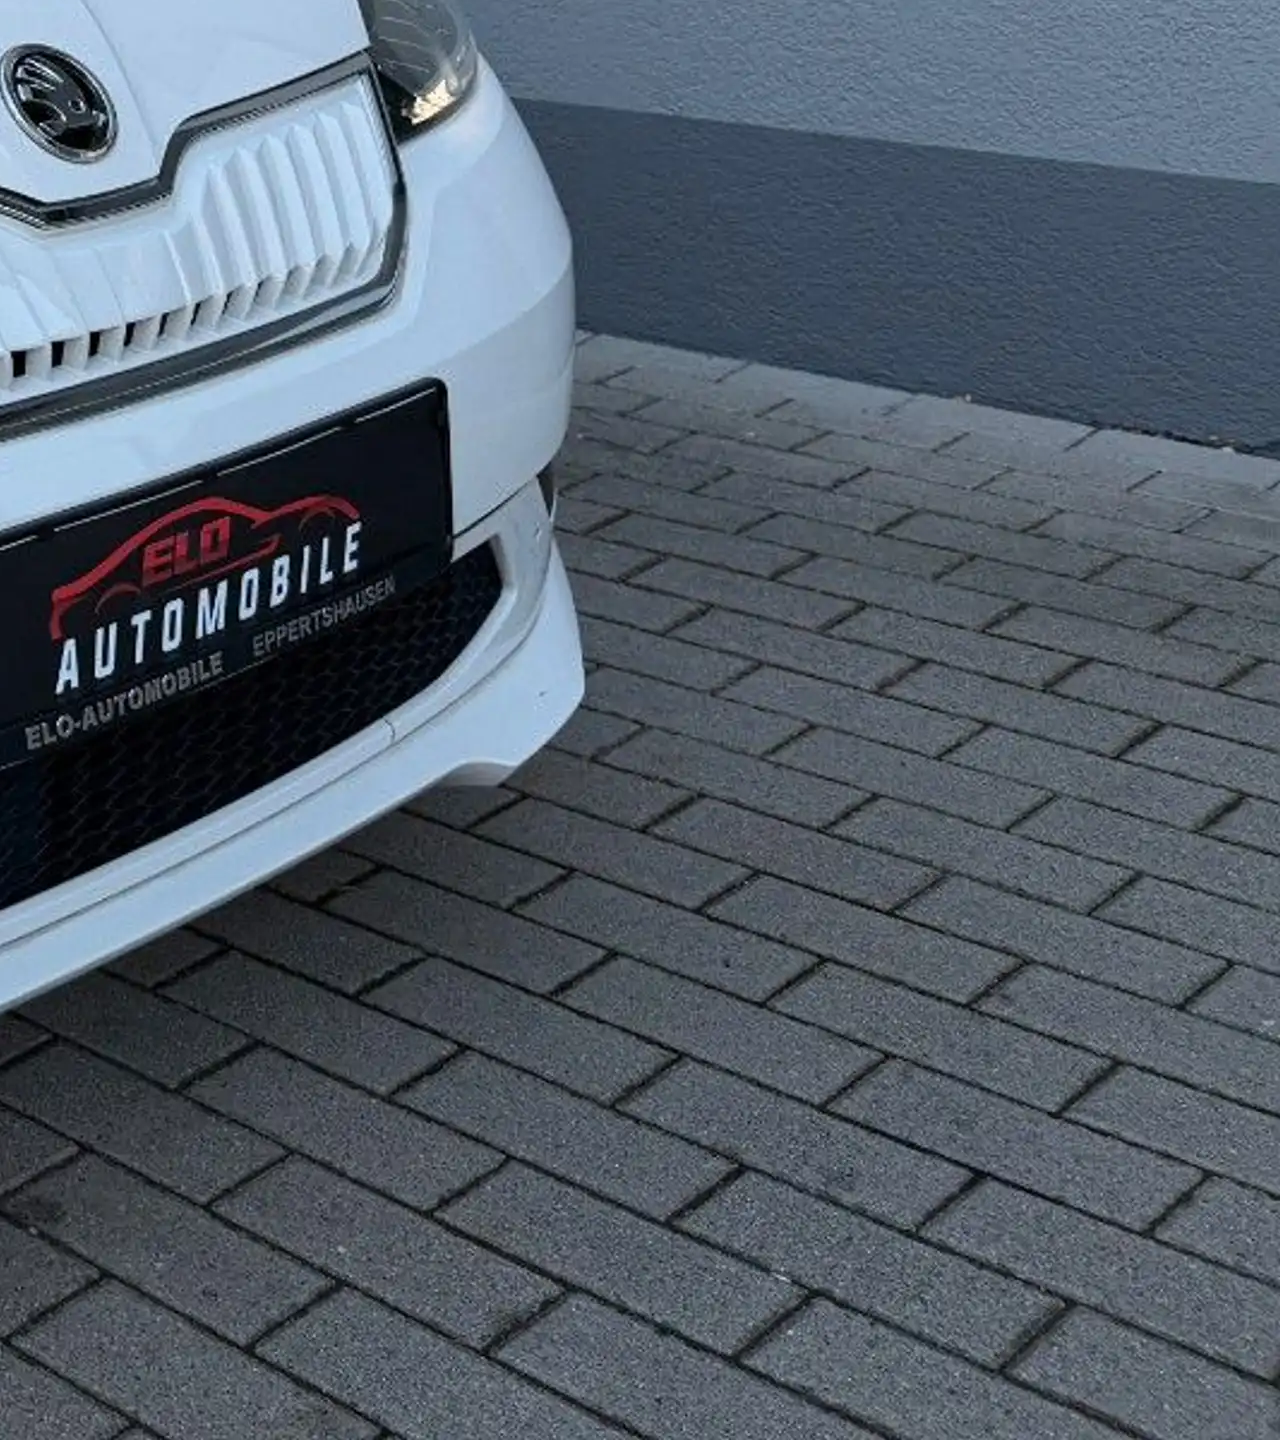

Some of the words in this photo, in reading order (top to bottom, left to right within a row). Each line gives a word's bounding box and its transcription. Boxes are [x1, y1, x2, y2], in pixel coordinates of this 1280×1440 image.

[55, 520, 362, 696] AUTOMOBILE
[142, 516, 232, 587] ELO
[24, 650, 225, 750] ELO-AUTOMOBILE
[252, 574, 396, 658] EPPERTSHAUSEN
